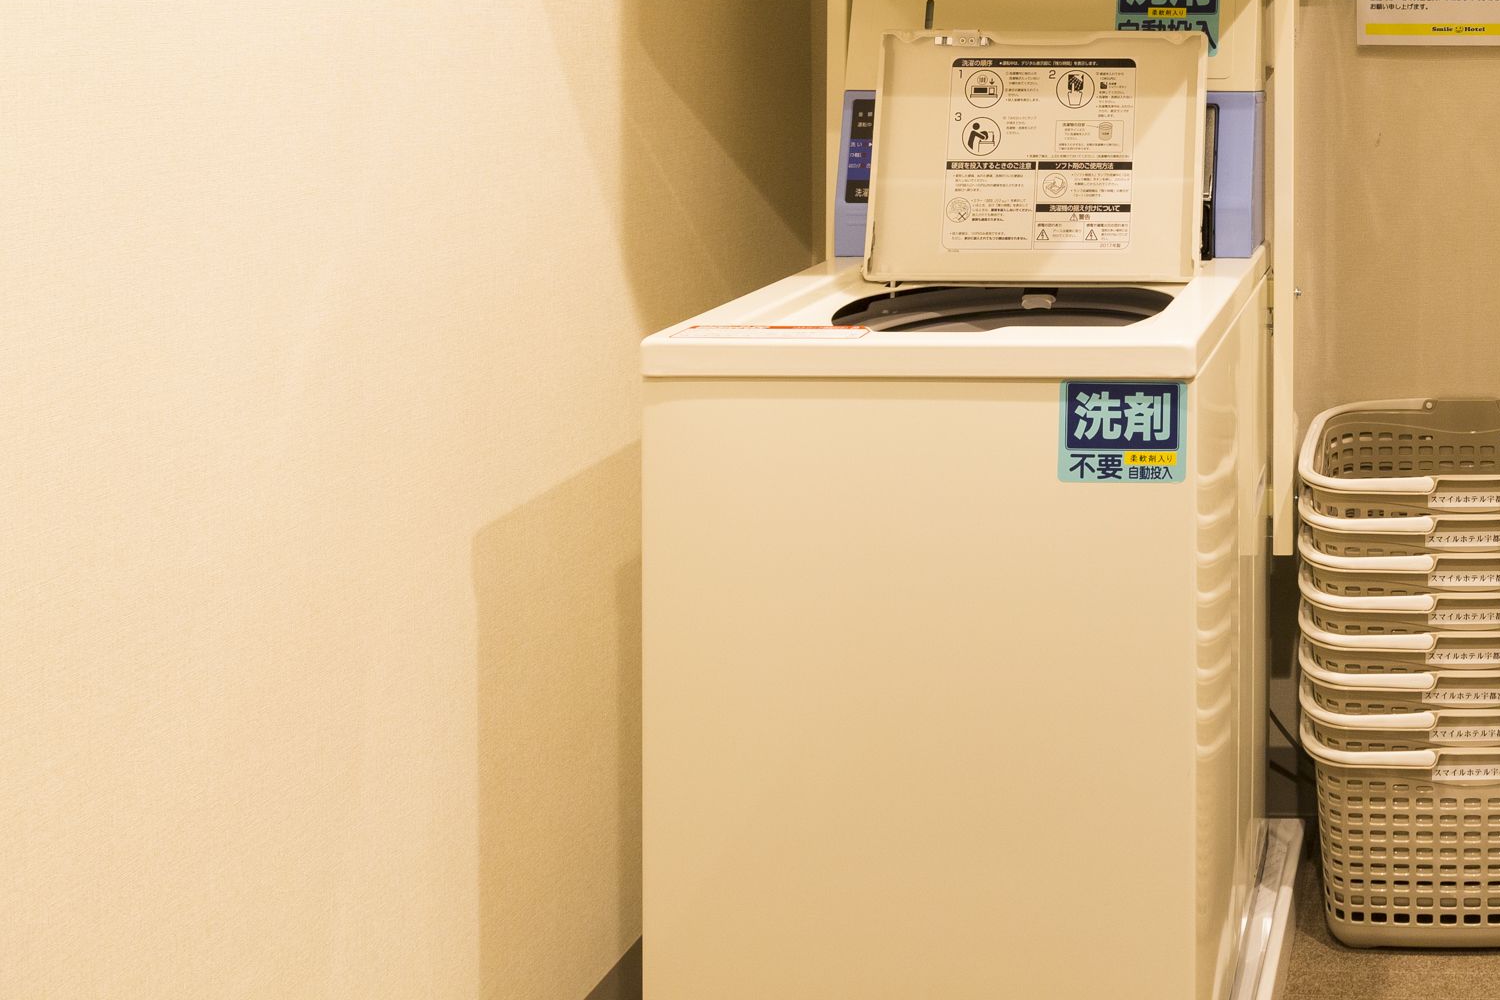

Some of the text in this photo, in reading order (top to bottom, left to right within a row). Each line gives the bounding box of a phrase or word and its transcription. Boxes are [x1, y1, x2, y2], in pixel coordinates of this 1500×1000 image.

[959, 70, 963, 78] 1
[1049, 70, 1056, 79] 2
[955, 113, 962, 121] 3
[1074, 391, 1171, 441] 洗剤
[1130, 454, 1173, 463] 柔軟剤入り
[1069, 454, 1123, 479] 不要
[1128, 466, 1173, 480] 自動投入
